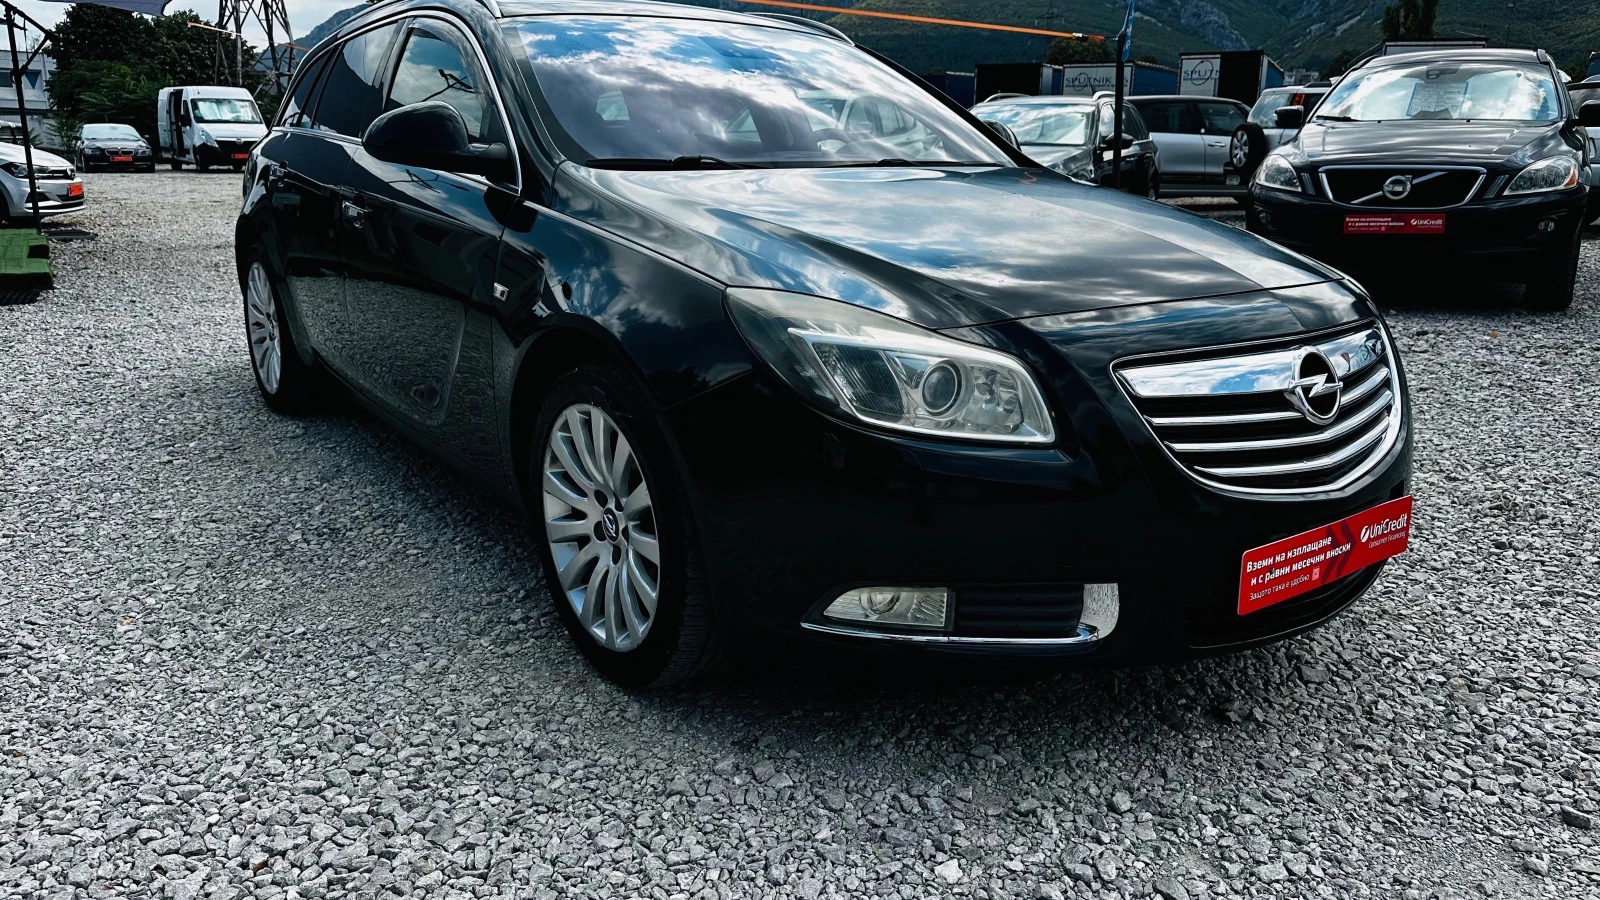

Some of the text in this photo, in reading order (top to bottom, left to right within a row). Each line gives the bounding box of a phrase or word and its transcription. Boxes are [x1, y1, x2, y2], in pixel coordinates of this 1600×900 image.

[1065, 76, 1112, 84] SPUTNIK
[1370, 513, 1408, 539] UniCredit
[1246, 536, 1332, 573] Вземи на изплащане
[1369, 537, 1388, 549] Consumer
[1250, 542, 1351, 586] и с равни месечни вноски
[1249, 587, 1272, 601] Защото
[1290, 574, 1310, 588] удобно
